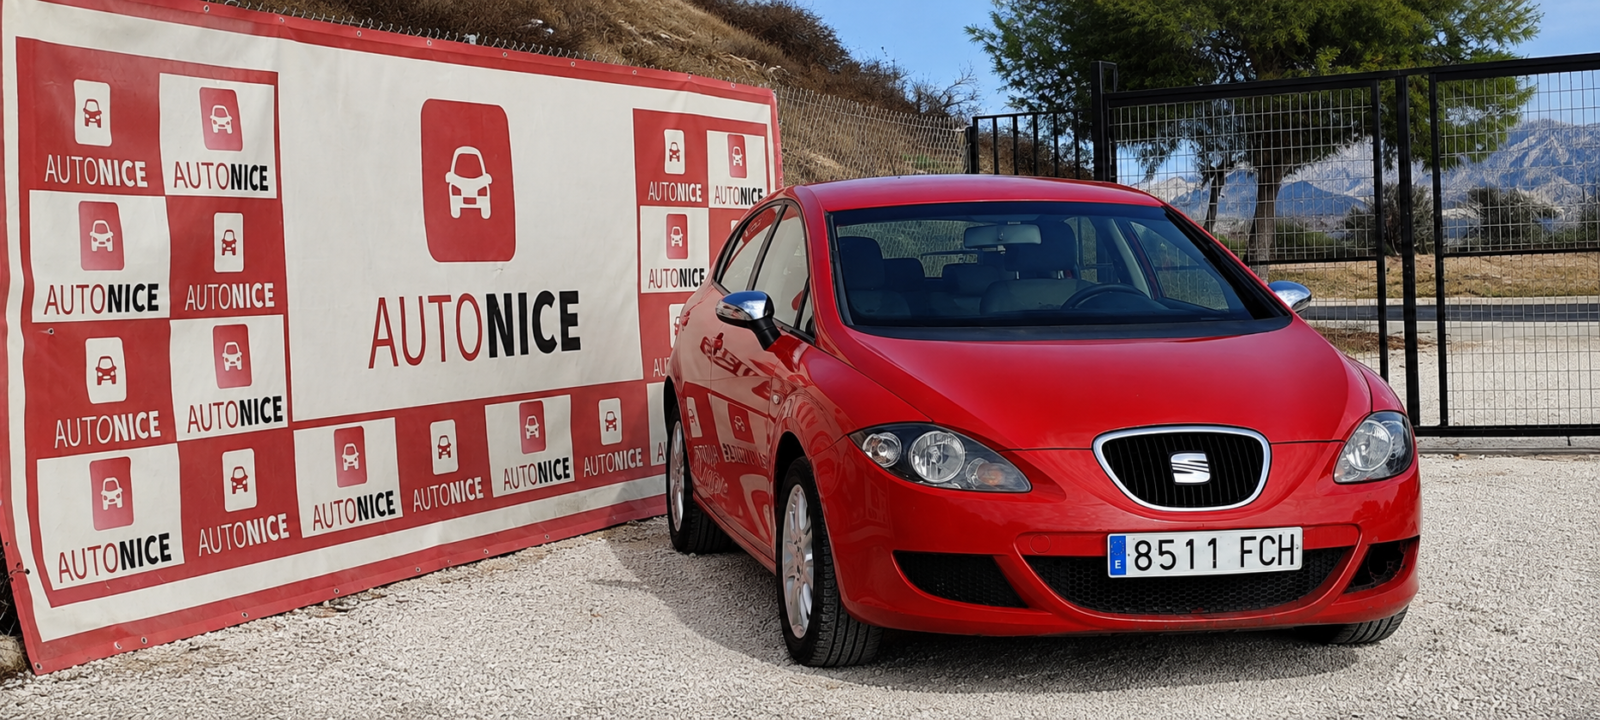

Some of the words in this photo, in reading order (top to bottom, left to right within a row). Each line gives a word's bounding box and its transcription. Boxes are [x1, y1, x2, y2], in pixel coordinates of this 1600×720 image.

[44, 154, 148, 188] AUTONICE
[174, 161, 269, 192] AUTONICE
[648, 181, 702, 203] AUTONICE
[648, 268, 705, 289] AUTONICE
[44, 283, 159, 315] AUTONICE
[185, 282, 275, 311] AUTONICE
[368, 290, 581, 369] AUTONICE
[54, 411, 161, 449] AUTONICE
[187, 396, 283, 433] AUTONICE
[503, 457, 571, 491] AUTONICE
[583, 447, 643, 478] AUTONICE
[313, 490, 396, 531] AUTONICE
[413, 476, 484, 513] AUTONICE
[199, 513, 290, 557] AUTONICE
[58, 532, 172, 583] AUTONICE
[1114, 560, 1122, 569] E
[1134, 537, 1218, 571] 8511
[1240, 534, 1295, 568] FCH
